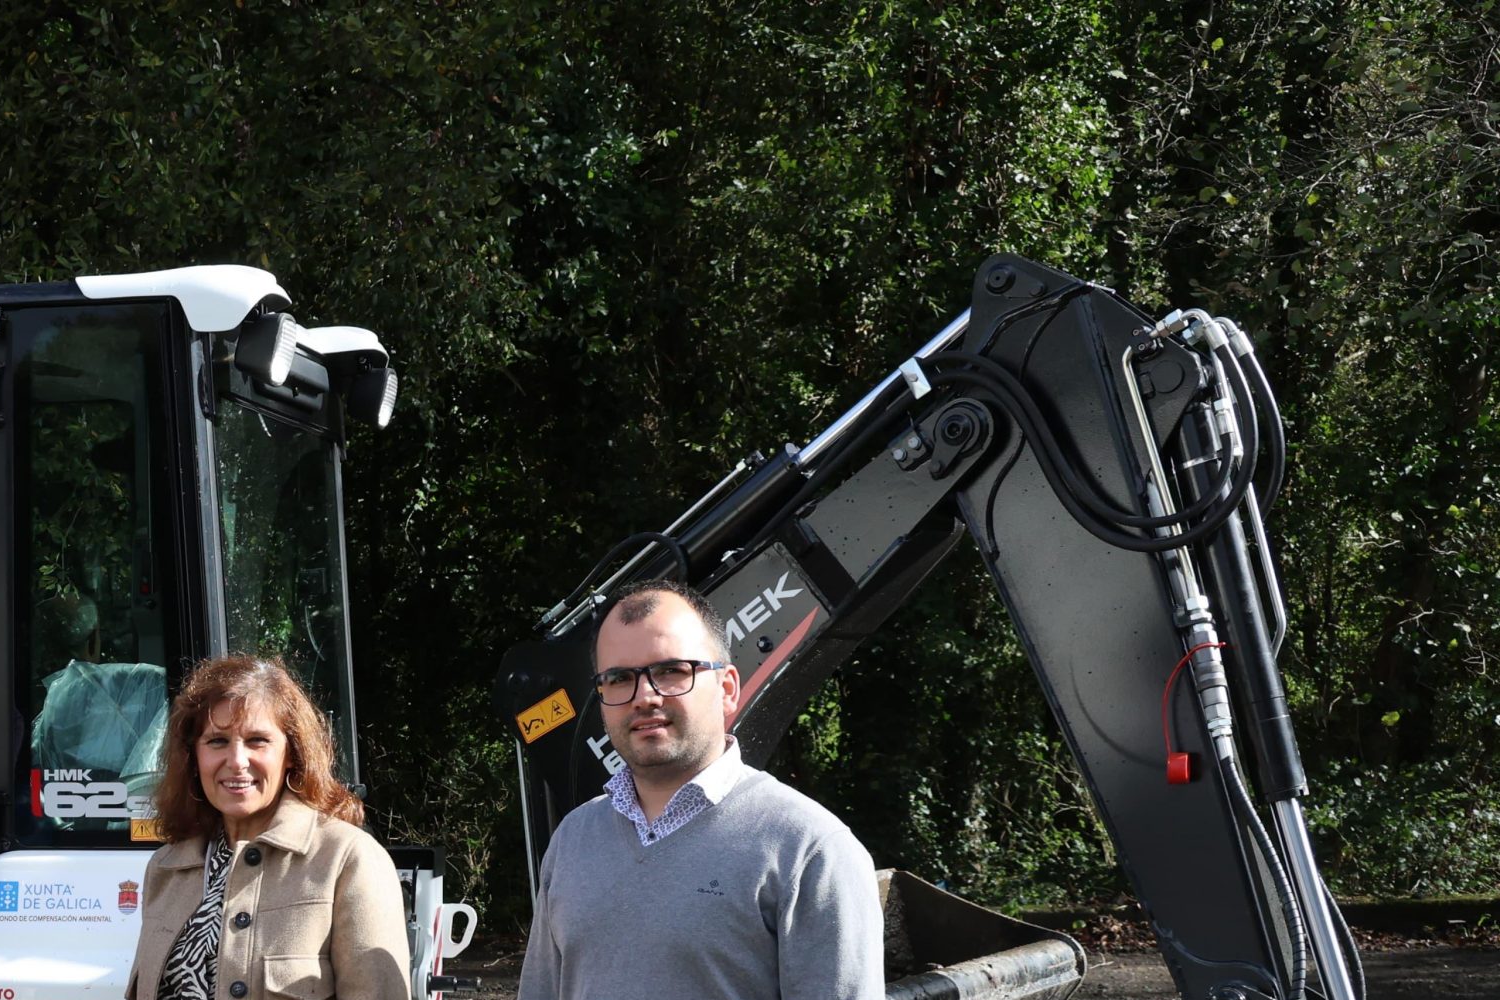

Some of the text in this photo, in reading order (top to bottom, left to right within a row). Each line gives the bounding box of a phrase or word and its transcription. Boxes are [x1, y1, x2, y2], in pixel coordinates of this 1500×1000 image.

[43, 768, 93, 782] HMK
[24, 883, 73, 896] XUNTA
[23, 897, 102, 911] DE GALICIA
[19, 914, 28, 922] DE
[28, 914, 78, 923] COMPENSACIÓN
[78, 914, 112, 923] AMBIENTAL
